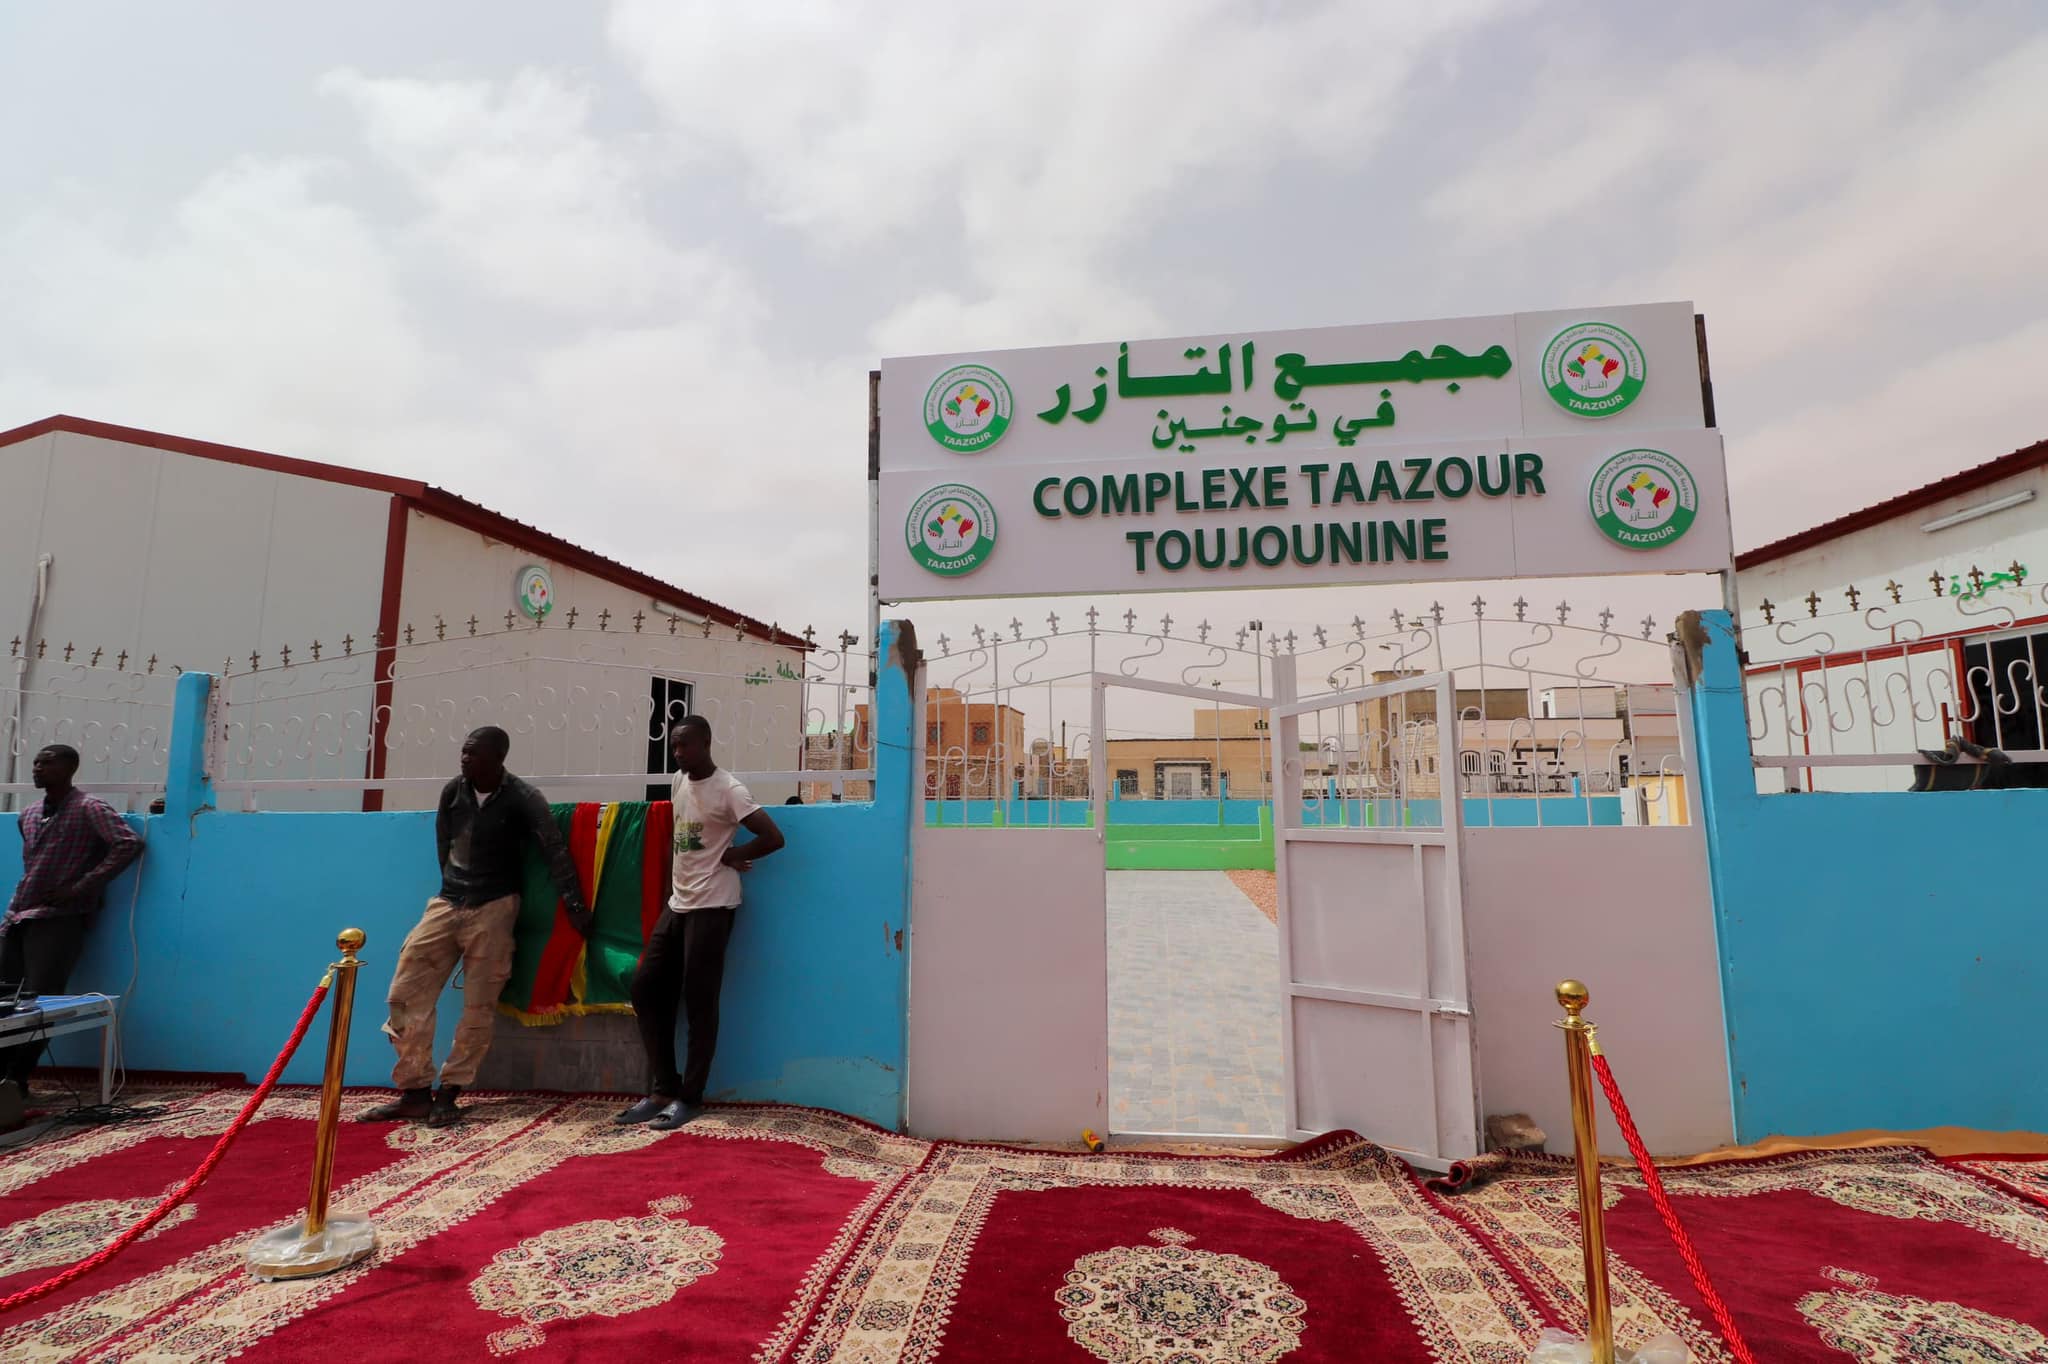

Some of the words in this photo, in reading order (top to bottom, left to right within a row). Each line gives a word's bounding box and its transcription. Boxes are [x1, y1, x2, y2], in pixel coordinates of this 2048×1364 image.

[1037, 341, 1256, 424] التأزر
[1274, 344, 1512, 401] مجمع
[1151, 402, 1317, 453] توجنين
[1333, 388, 1395, 447] في
[1568, 394, 1624, 411] TAAZOUR
[943, 431, 992, 447] TAAZOUR
[1032, 466, 1289, 517] COMPLEXE
[1301, 453, 1546, 505] TAAZOUR
[1126, 518, 1449, 573] TOUJOUNINE
[1617, 525, 1676, 542] TAAZOUR
[927, 553, 976, 570] TAAZOUR
